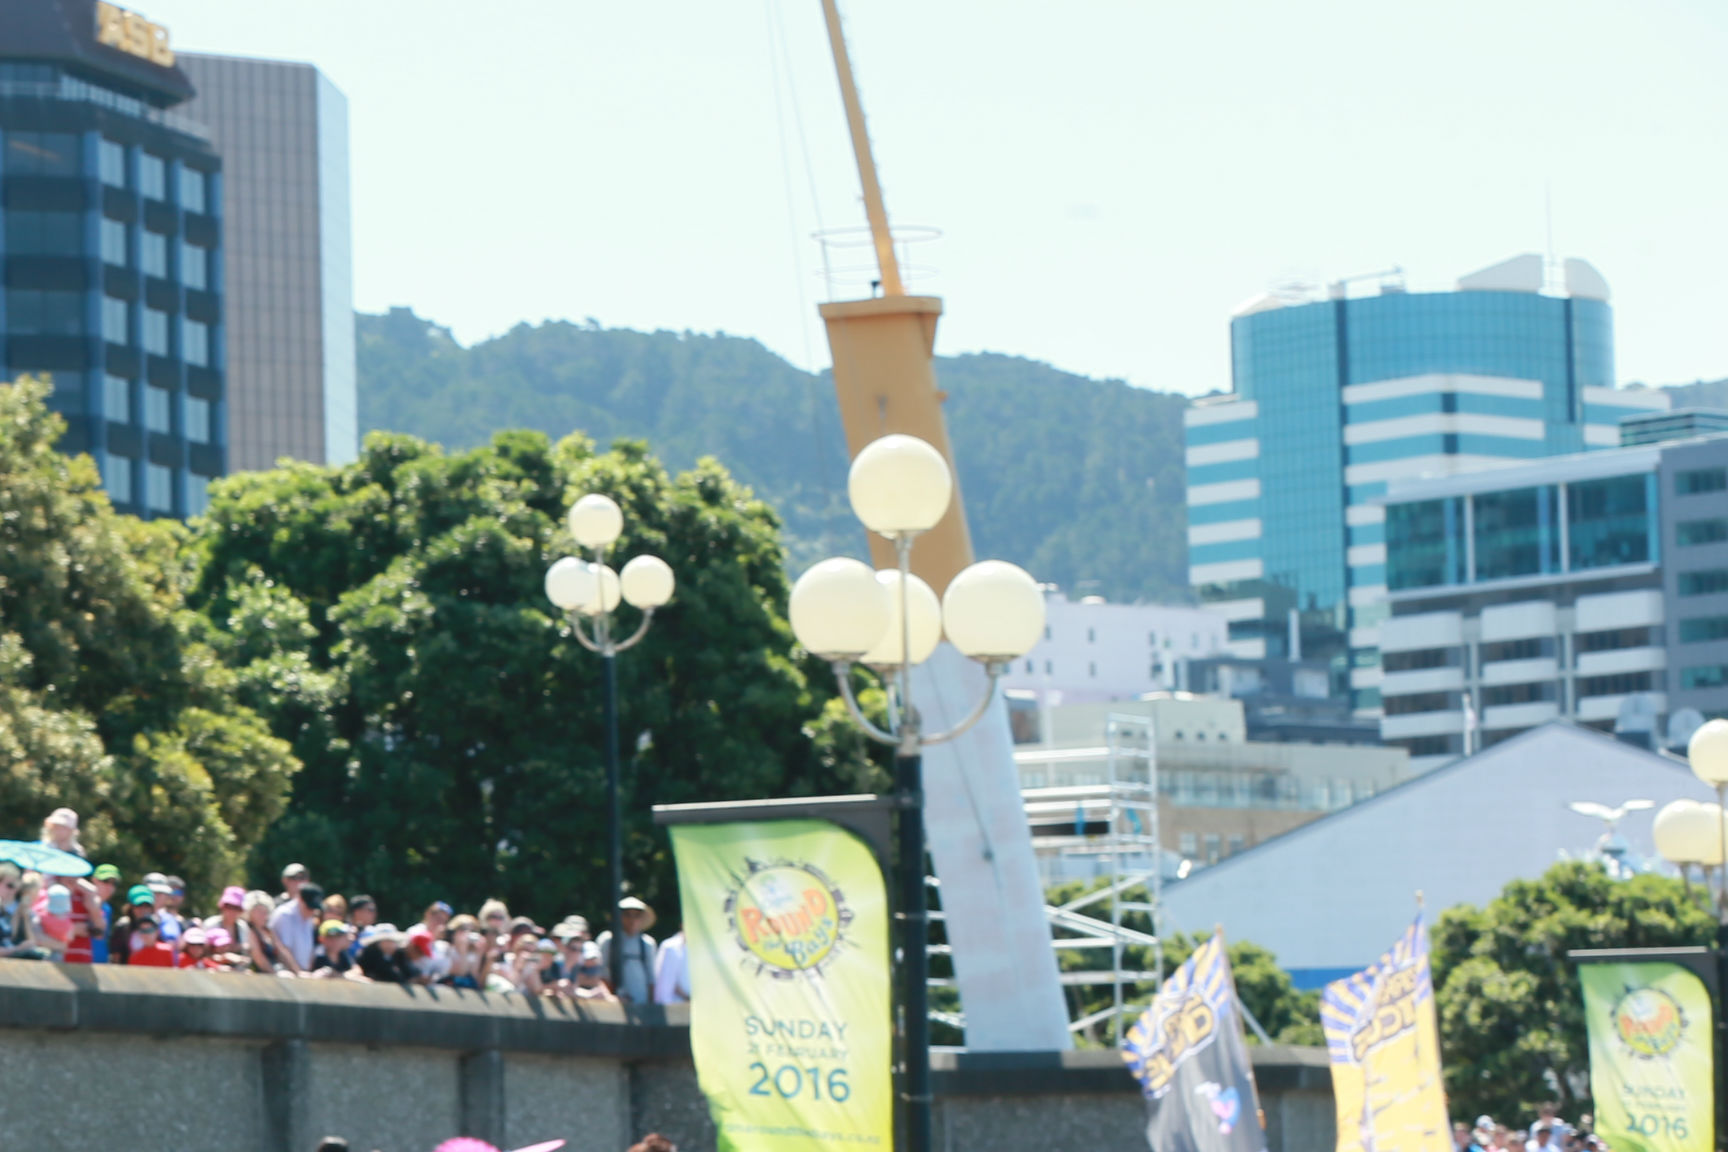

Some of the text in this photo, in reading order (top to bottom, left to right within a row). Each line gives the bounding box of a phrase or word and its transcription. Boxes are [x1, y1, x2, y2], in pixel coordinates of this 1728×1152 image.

[744, 1015, 849, 1041] SUNDAY
[748, 1061, 851, 1103] 2016
[1626, 1112, 1689, 1140] 2016
